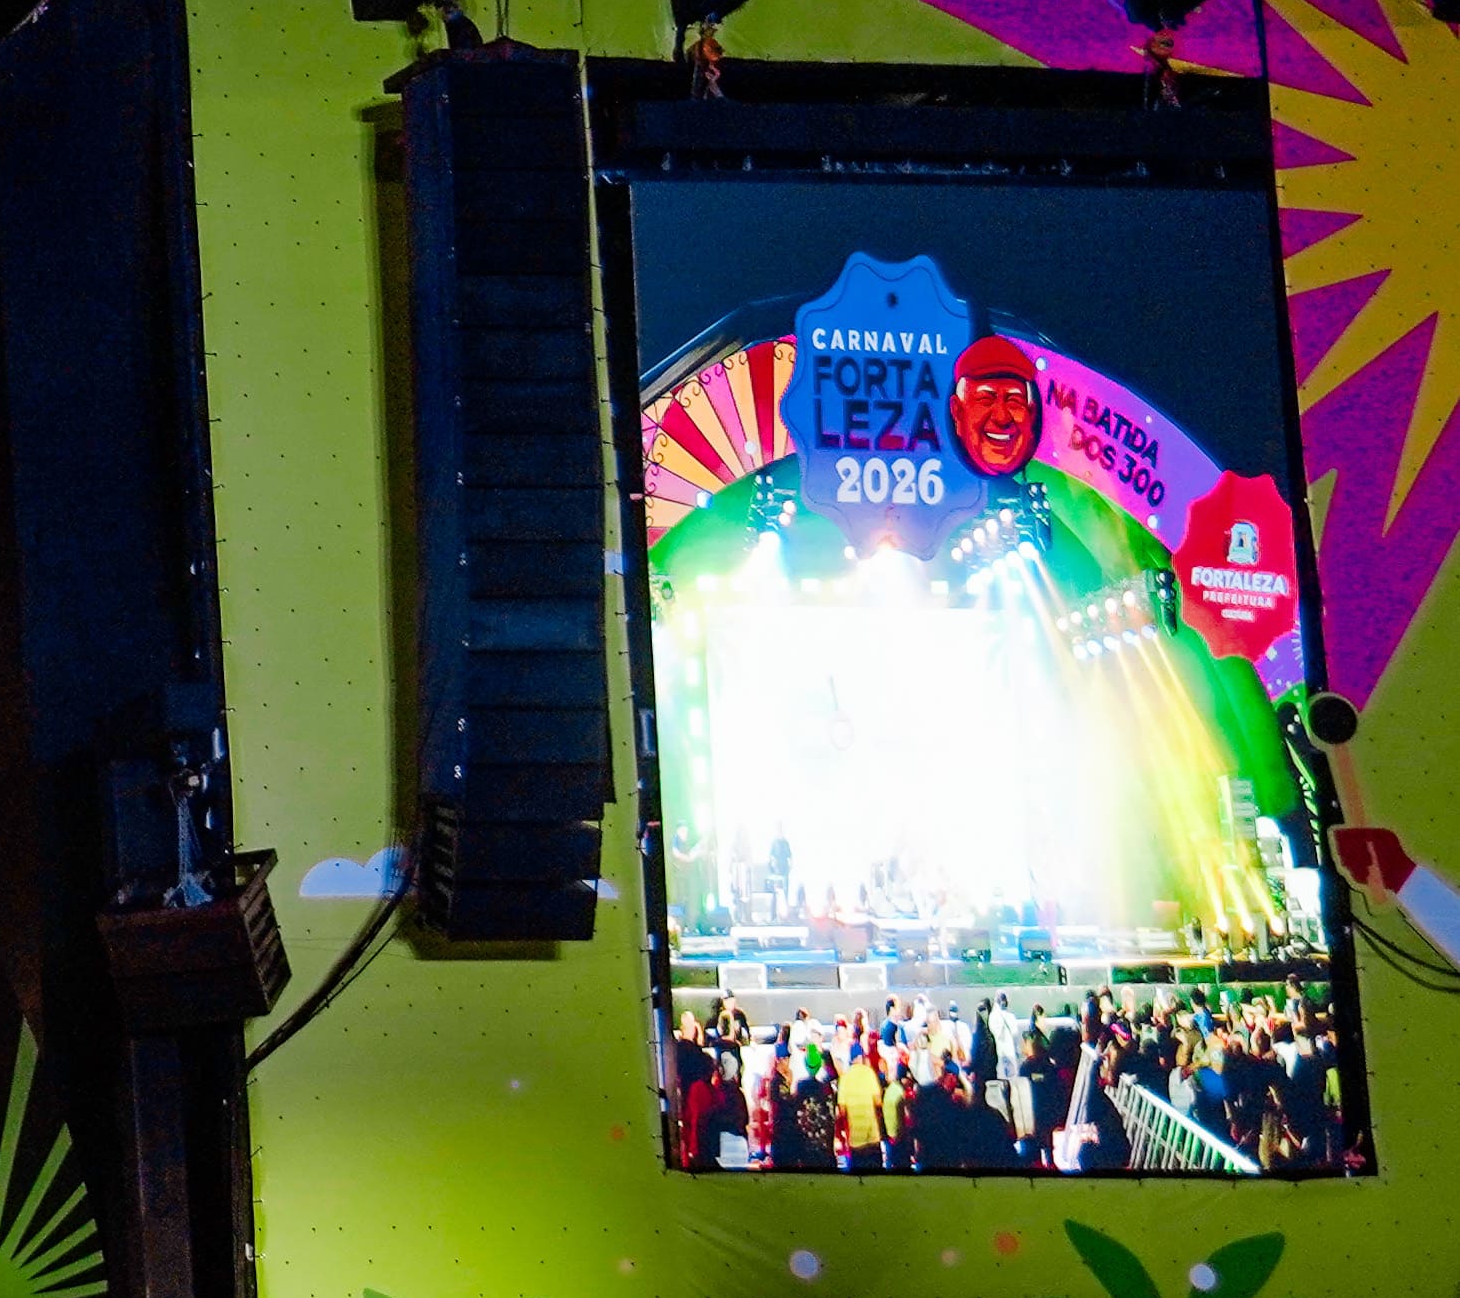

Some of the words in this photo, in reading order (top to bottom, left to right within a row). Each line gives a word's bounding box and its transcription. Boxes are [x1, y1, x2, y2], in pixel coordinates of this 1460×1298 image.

[812, 328, 947, 354] CARNAVAL
[813, 355, 940, 399] FORTA
[814, 398, 942, 452] LEZA
[1046, 380, 1077, 414] NA
[1083, 398, 1159, 469] BATIDA
[835, 456, 944, 505] 2026
[1069, 424, 1116, 471] DOS
[1118, 455, 1165, 507] 300
[1191, 566, 1288, 595] FORTALEZA
[1203, 590, 1273, 608] PREFEITURA
